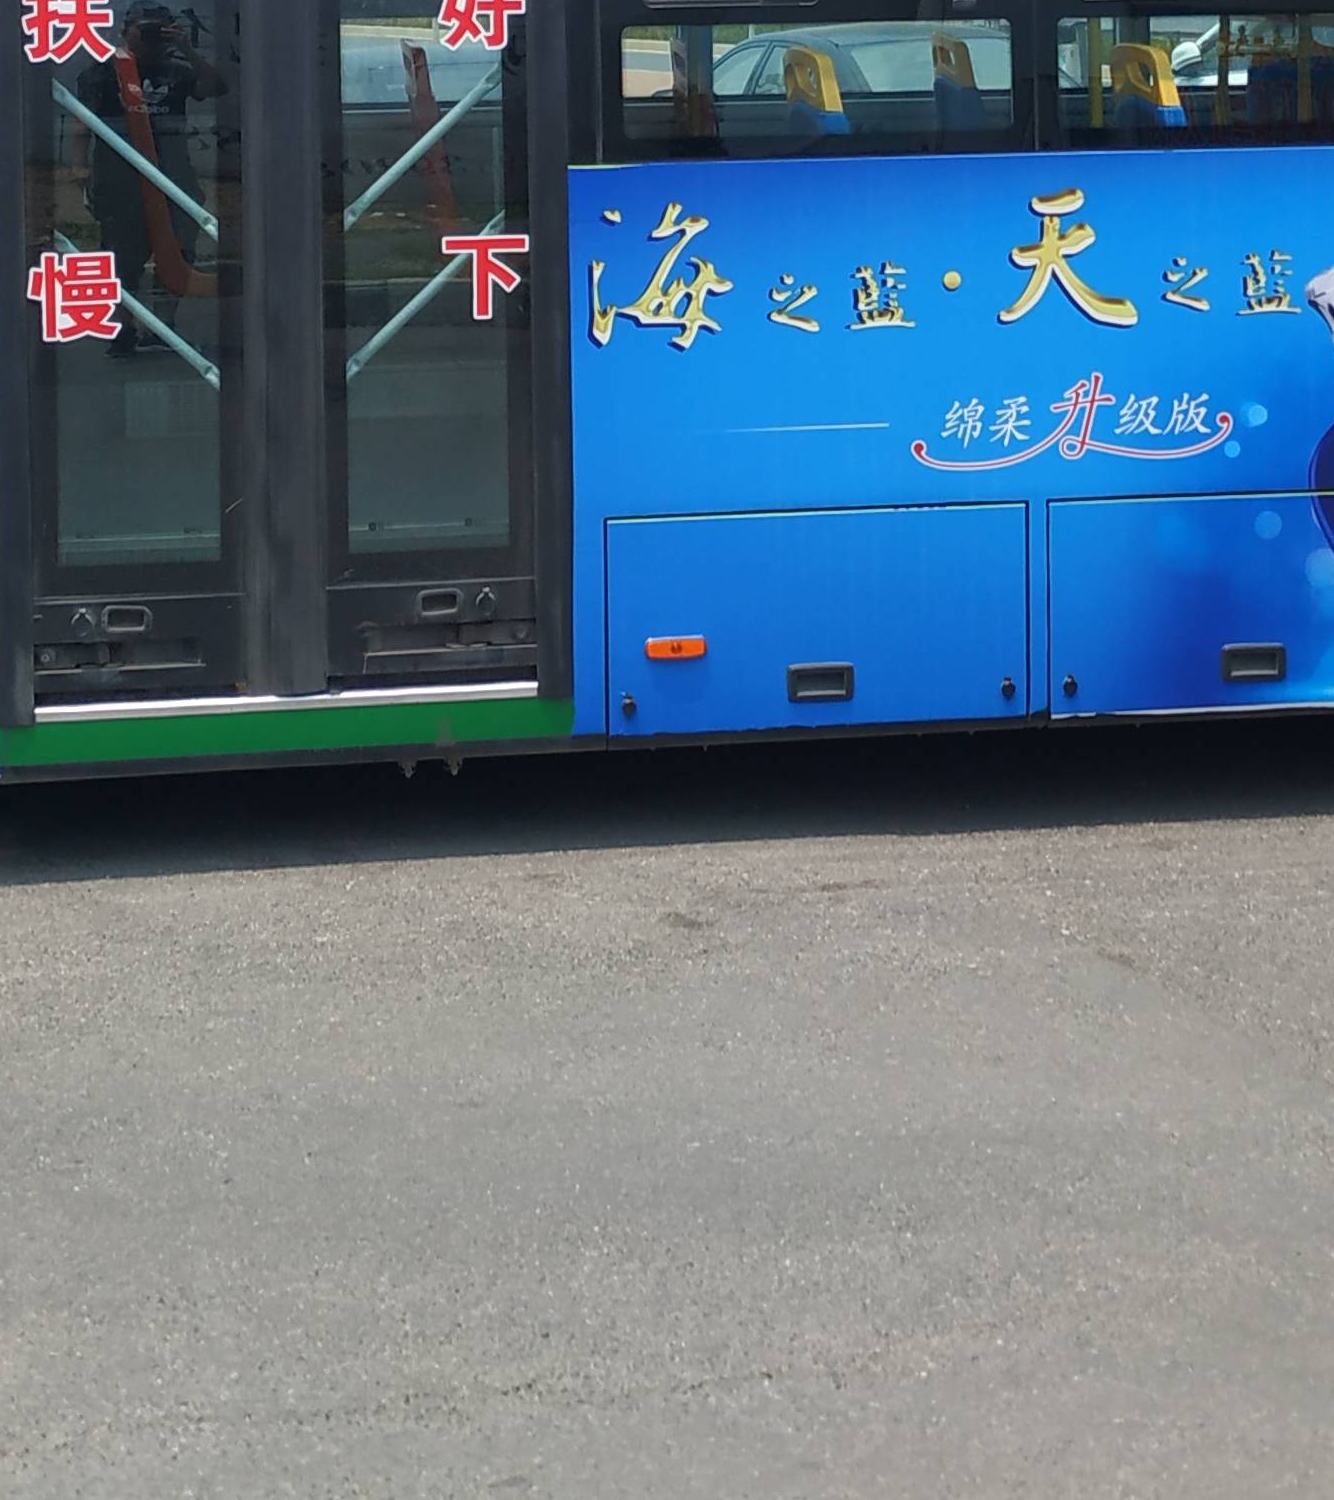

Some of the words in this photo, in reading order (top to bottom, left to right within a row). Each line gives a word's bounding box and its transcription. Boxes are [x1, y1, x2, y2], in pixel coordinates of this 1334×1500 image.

[27, 252, 123, 342] 慢
[442, 235, 530, 320] 下
[942, 372, 1213, 458] 绵柔升级版
